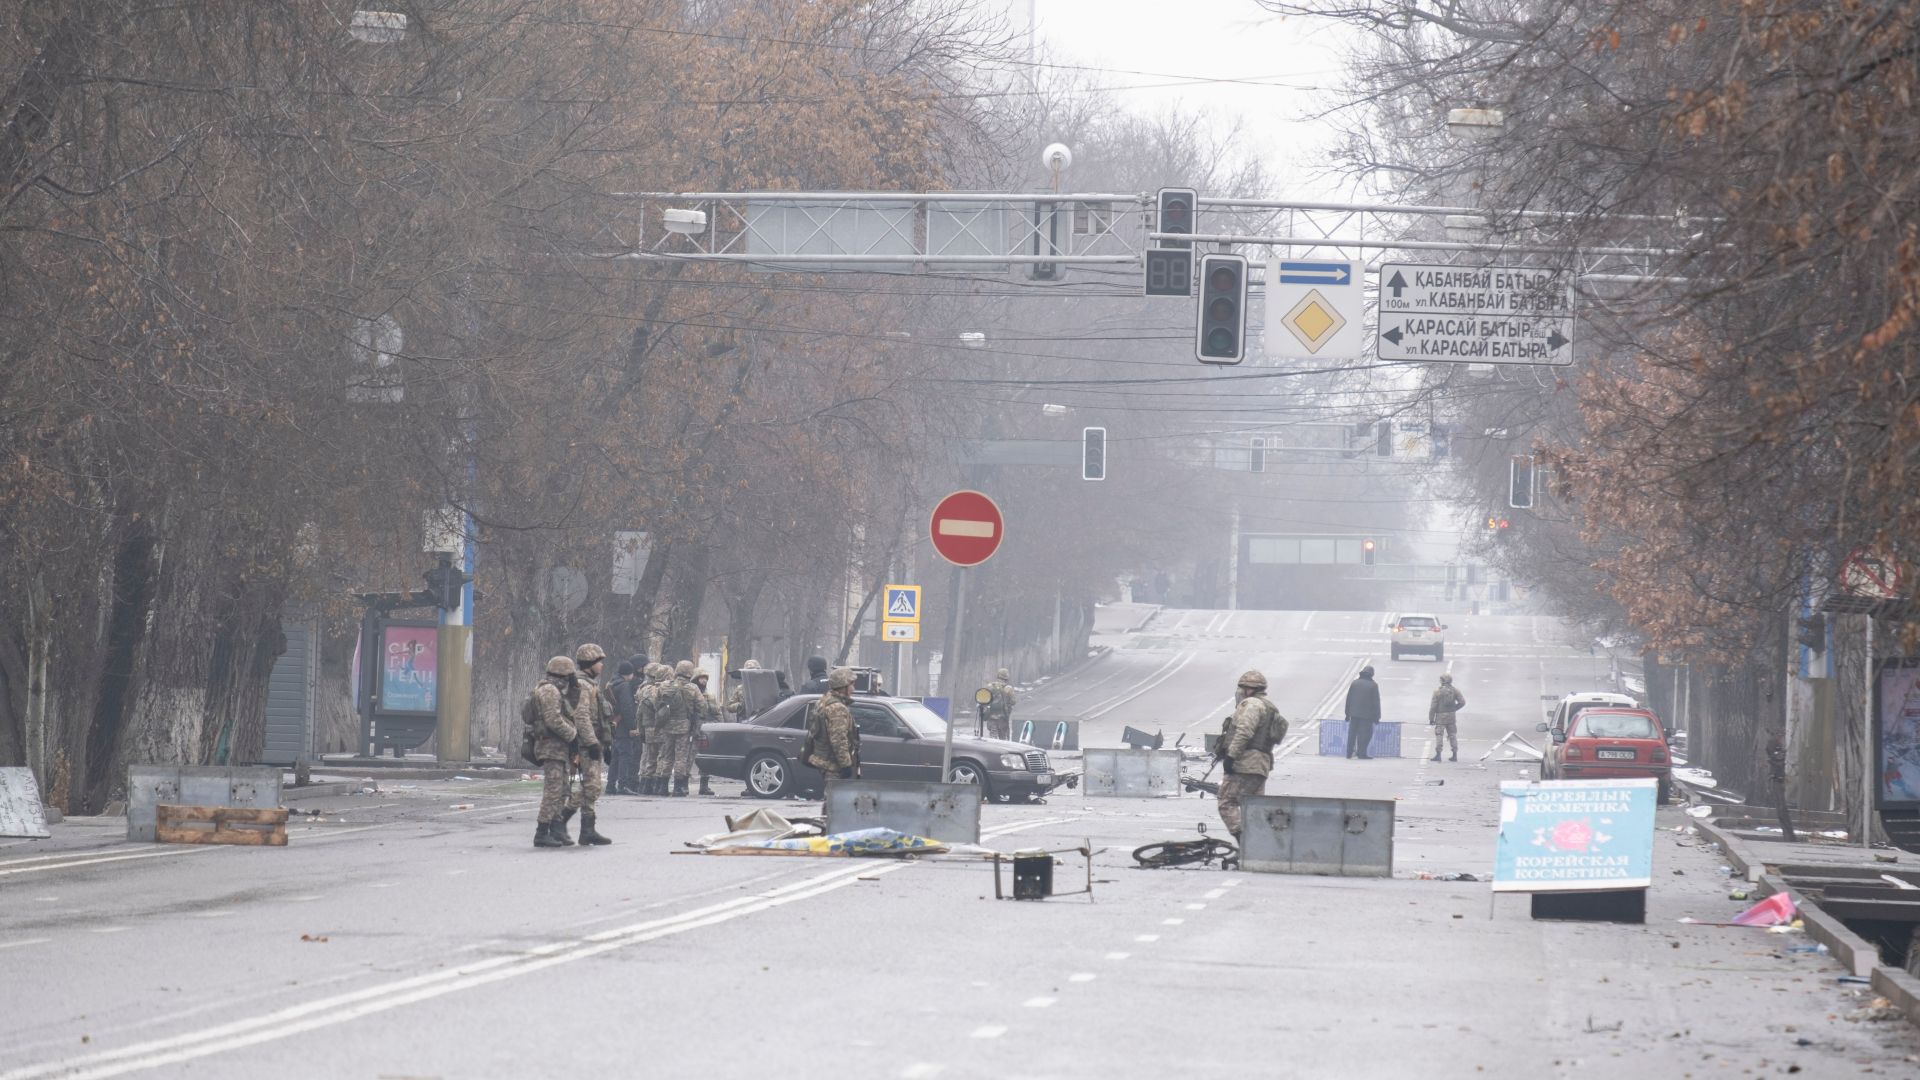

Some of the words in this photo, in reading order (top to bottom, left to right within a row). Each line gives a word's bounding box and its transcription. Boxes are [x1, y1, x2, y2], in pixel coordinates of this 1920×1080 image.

[1415, 271, 1491, 290] ҚАБАНБАЙ
[1385, 300, 1410, 309] 100м
[1429, 291, 1504, 309] КАБАНБАЙ
[1510, 293, 1569, 311] БАТЫРА
[1405, 317, 1475, 337] ҚАРАСАЙ
[1421, 339, 1488, 357] КАРАСАЙ
[1492, 342, 1547, 358] БАТЫРА
[1526, 790, 1632, 802] КОРЕЯЛЫК
[1525, 802, 1630, 813] КОСМЕТИКА
[1516, 855, 1629, 867] КОРЕЙСКАЯ
[1515, 868, 1628, 879] КОСМЕТИКА
